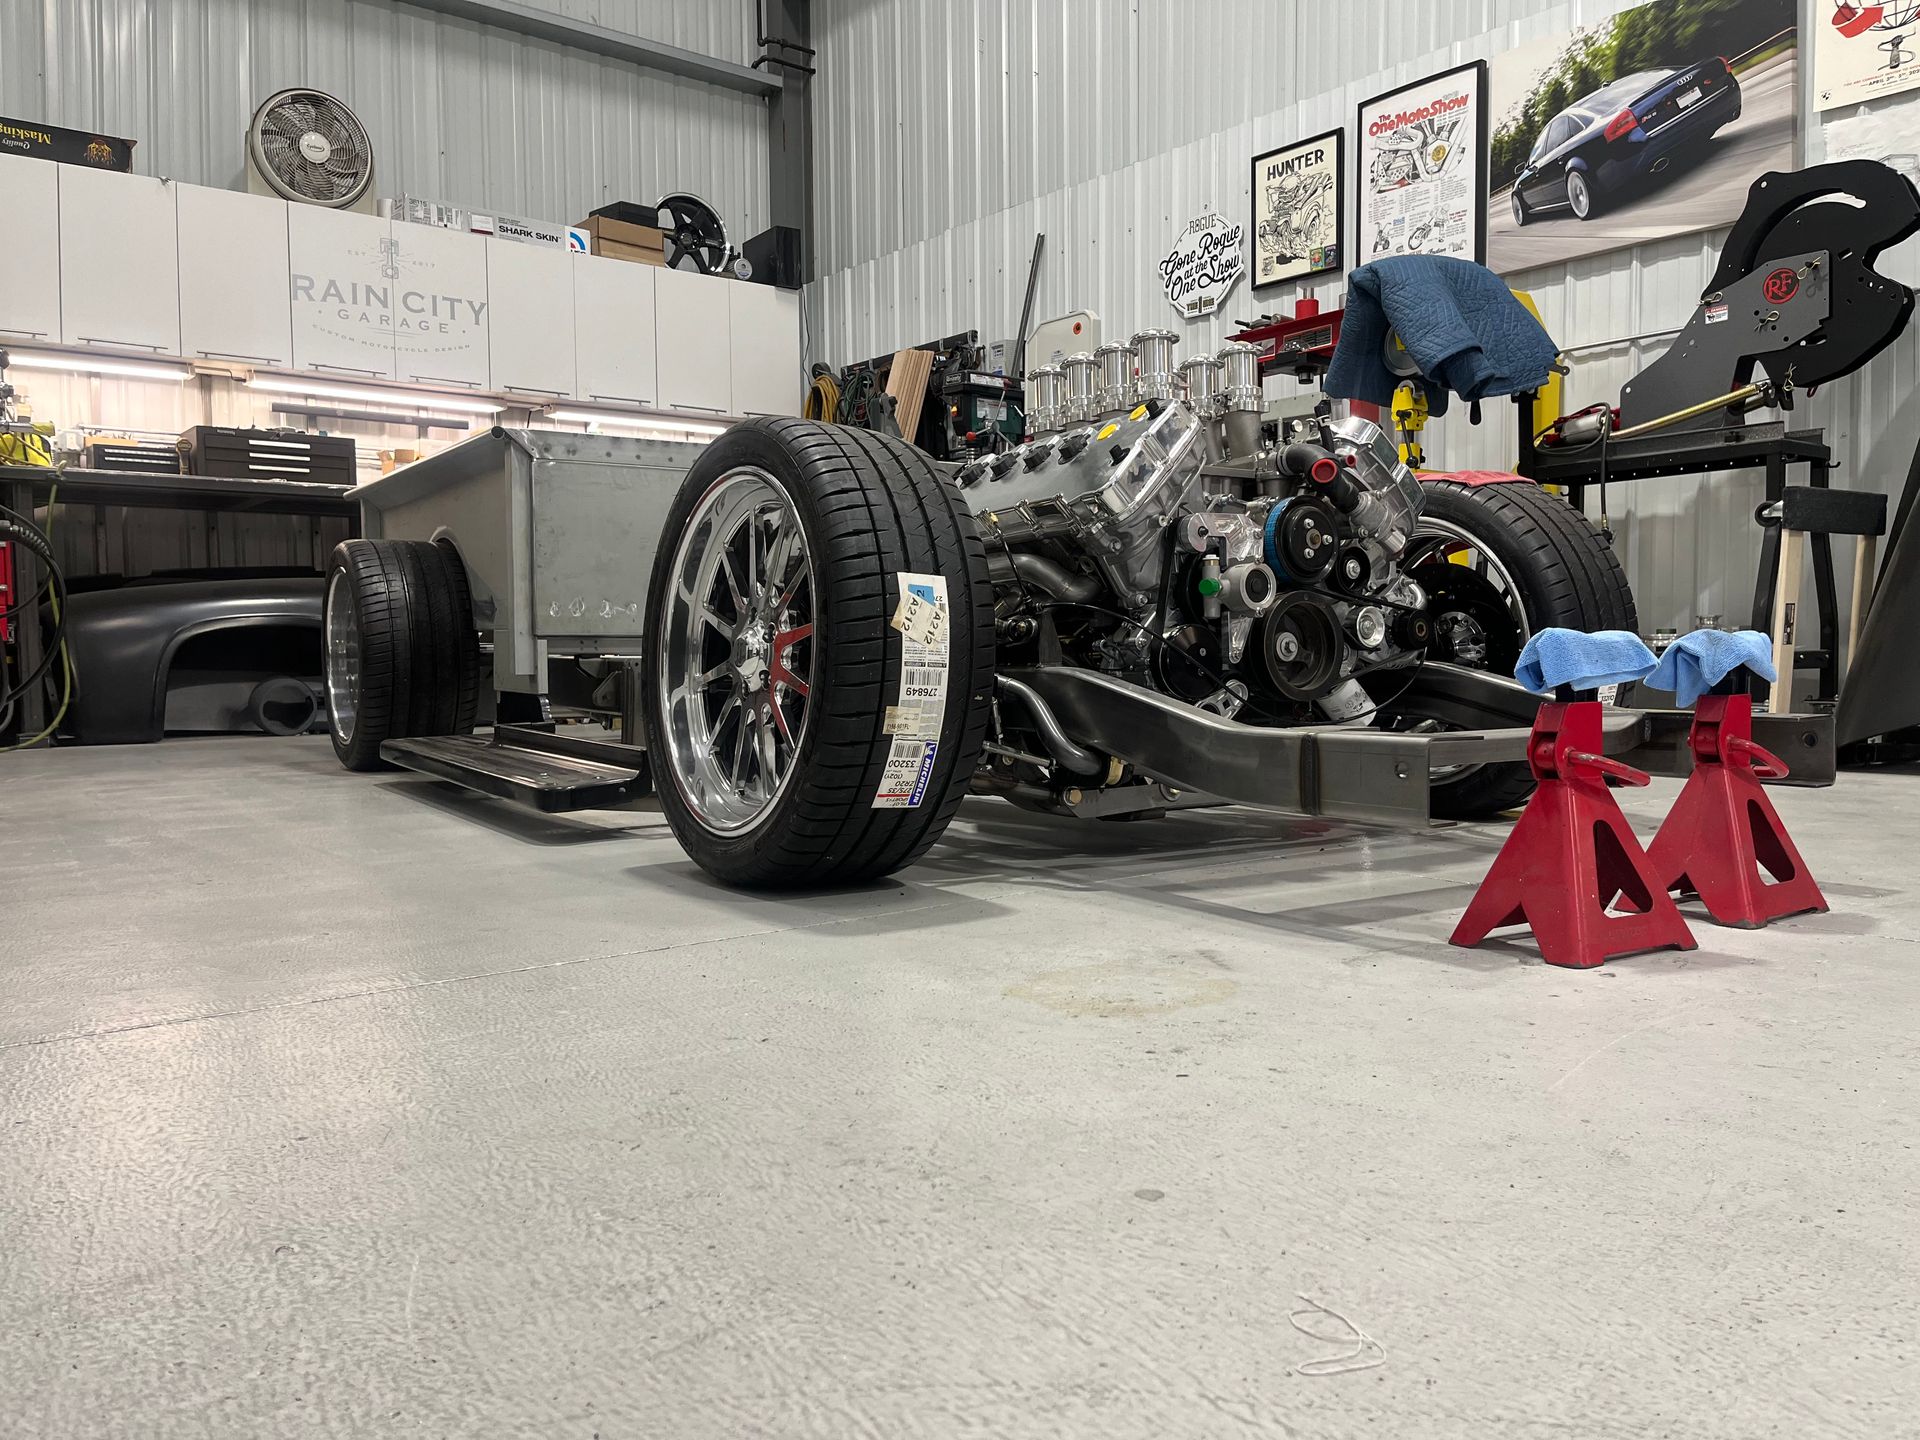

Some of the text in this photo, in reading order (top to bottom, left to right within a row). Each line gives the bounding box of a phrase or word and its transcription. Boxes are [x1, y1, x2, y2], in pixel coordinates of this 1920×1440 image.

[1379, 114, 1391, 122] The
[2, 138, 30, 150] Quality
[1267, 149, 1324, 181] HUNTER
[498, 225, 533, 238] SHARK
[1159, 225, 1240, 289] Gone Rogue
[1184, 260, 1208, 280] at the
[1171, 254, 1241, 302] One Show
[1768, 273, 1793, 298] RF
[292, 273, 487, 326] RAIN CITY
[1186, 301, 1198, 311] THE
[337, 308, 449, 334] GARAGE
[312, 324, 470, 353] CUSTOM MOTORCYCLE DESIGN
[901, 597, 919, 632] A212
[924, 611, 942, 645] A212
[906, 687, 938, 697] 276849
[888, 760, 916, 768] 33200
[912, 758, 932, 804] MICHELIN
